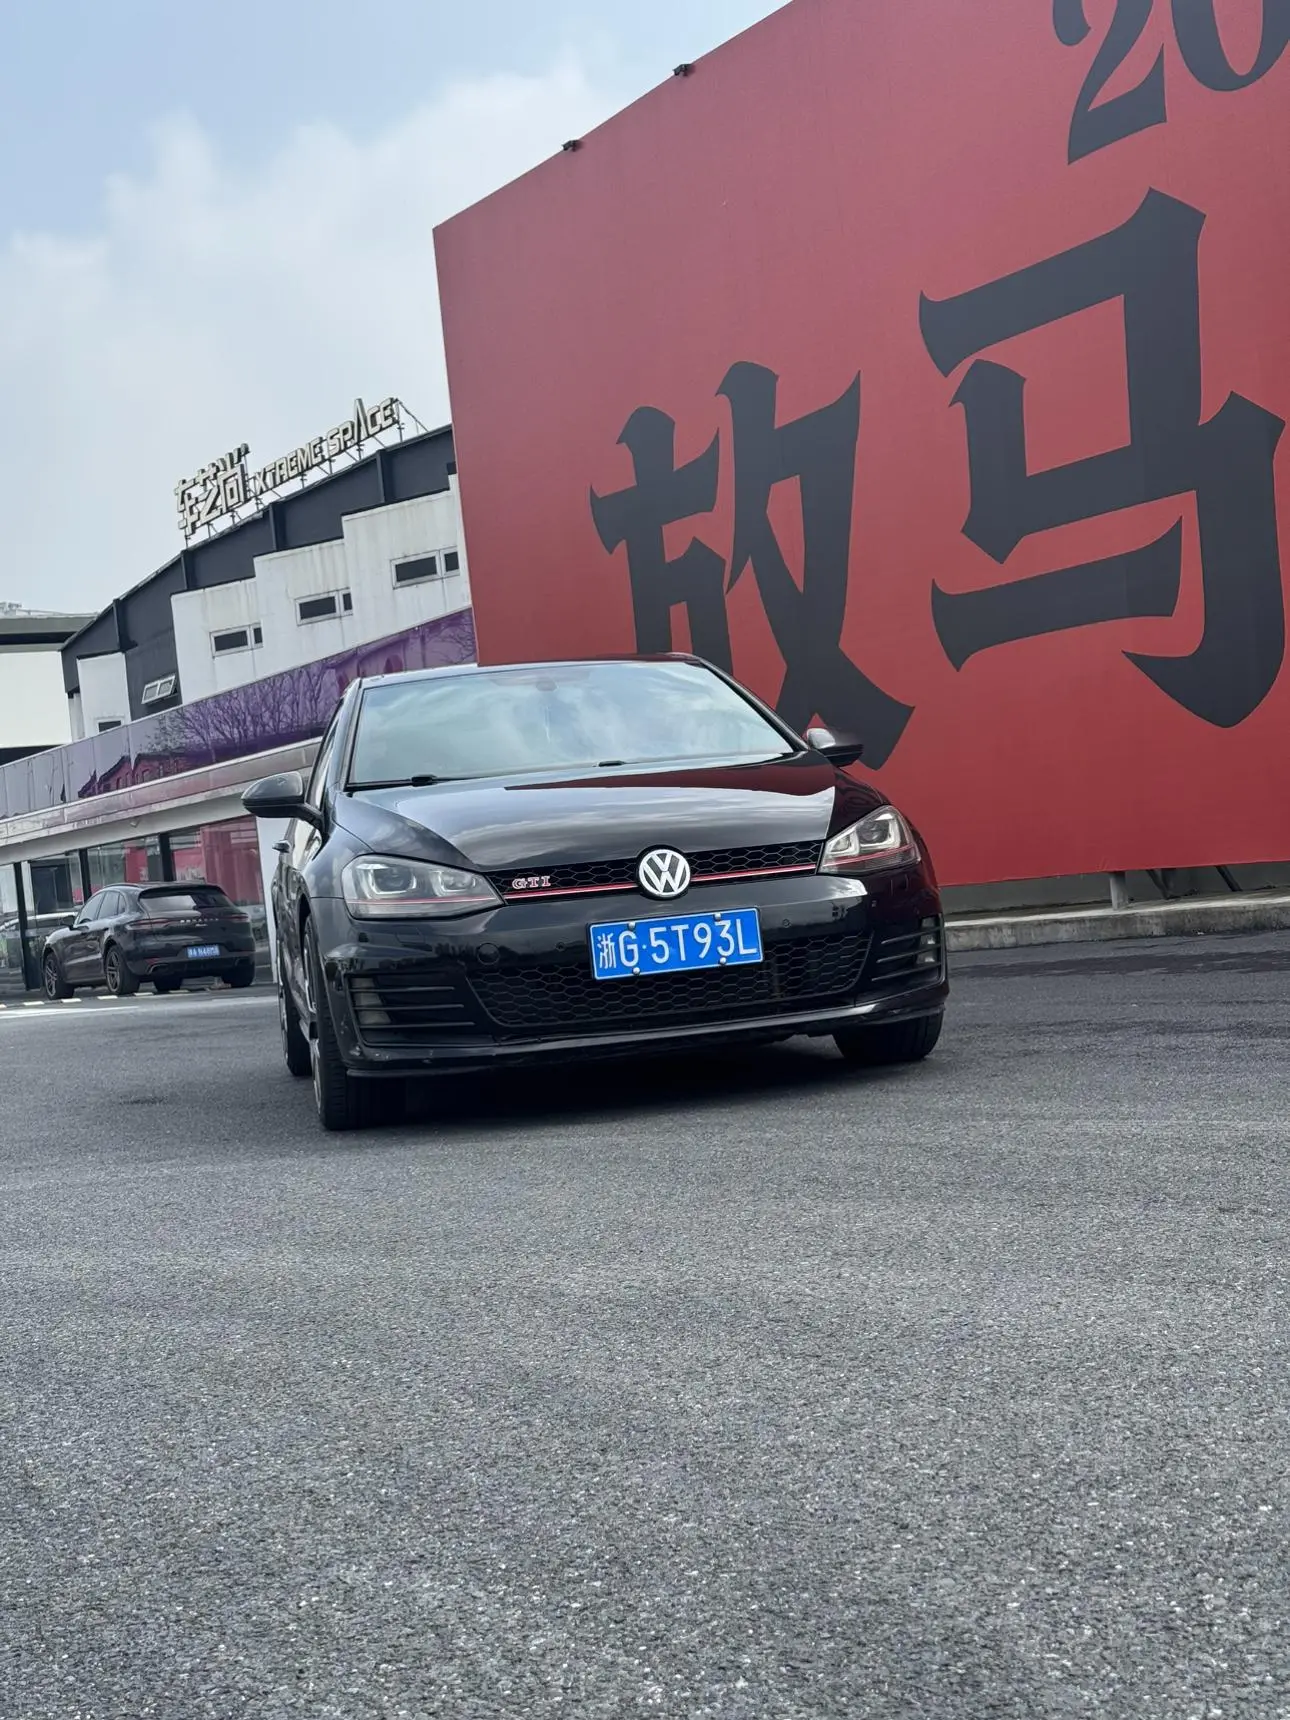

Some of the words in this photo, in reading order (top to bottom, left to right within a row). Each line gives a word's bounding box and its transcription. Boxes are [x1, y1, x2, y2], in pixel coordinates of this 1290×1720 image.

[326, 397, 395, 456] SPACE
[590, 187, 1286, 770] 放马
[511, 875, 551, 890] GTI
[640, 849, 691, 897] VW
